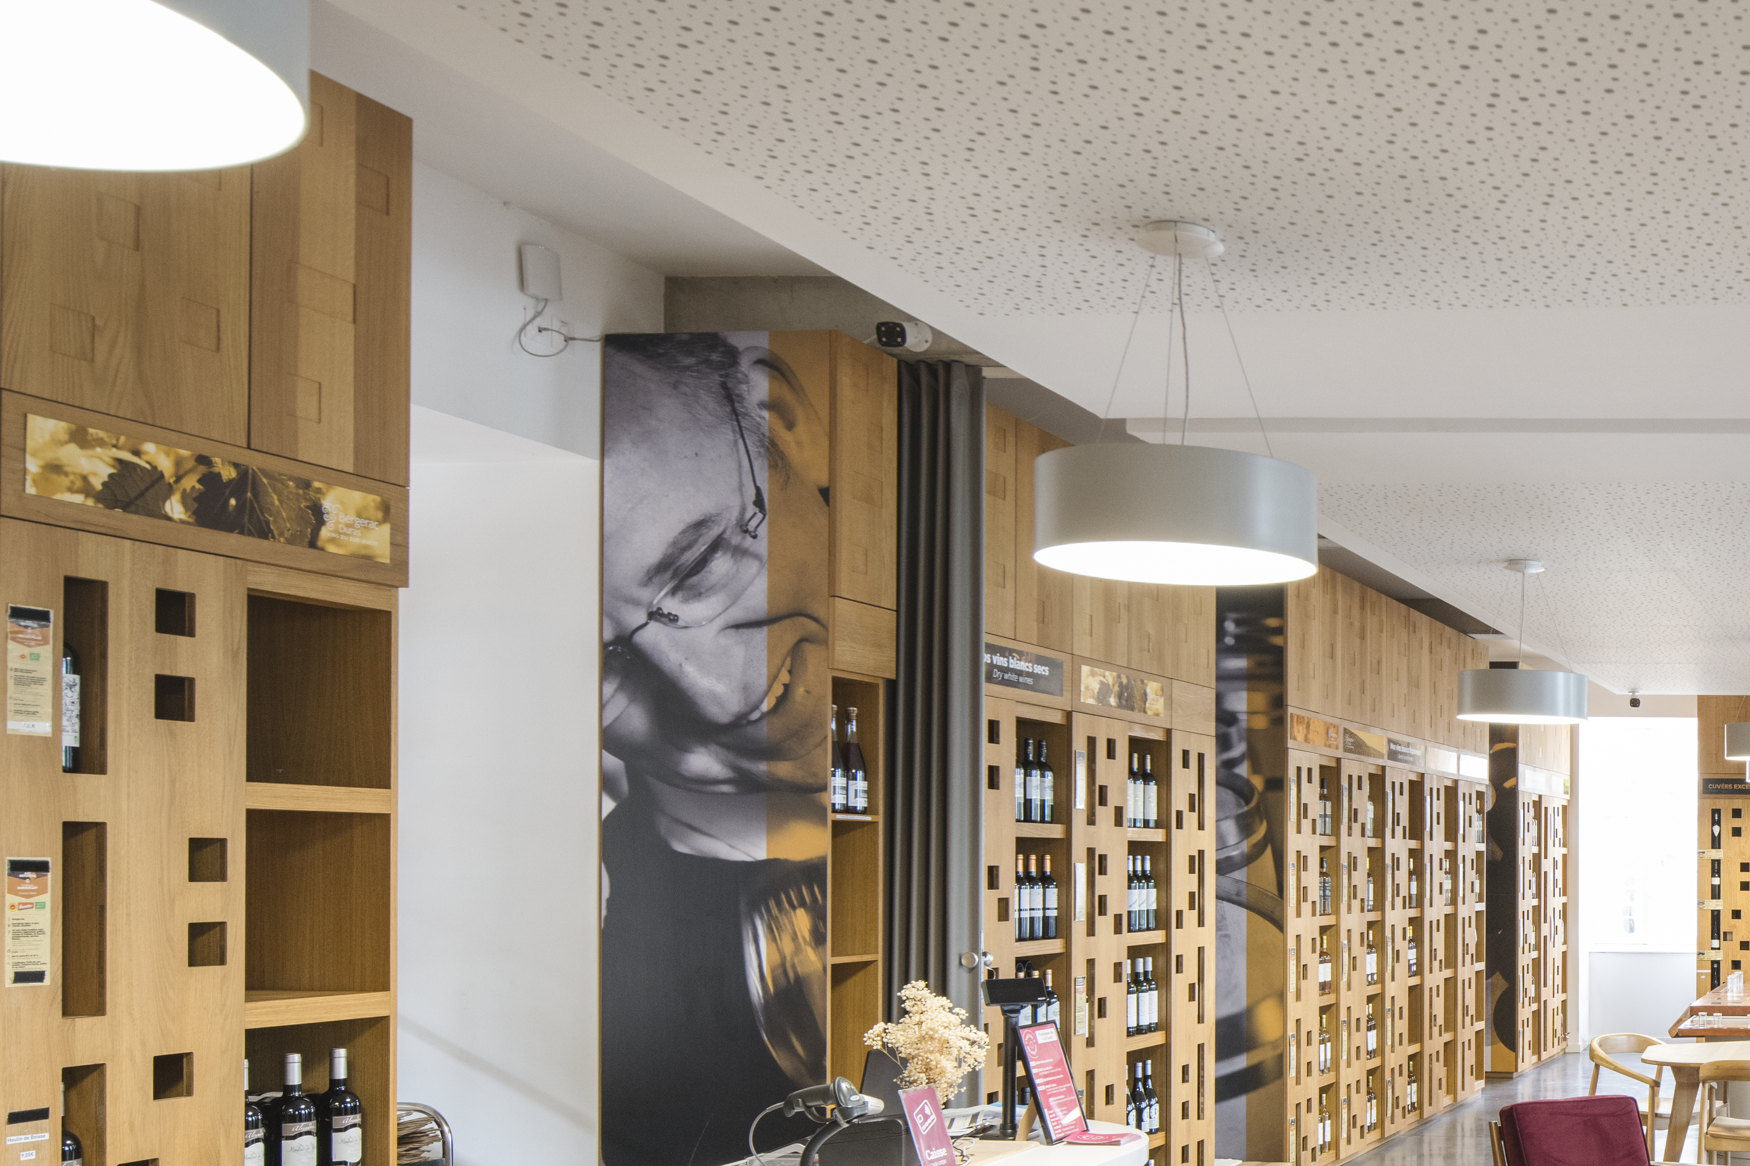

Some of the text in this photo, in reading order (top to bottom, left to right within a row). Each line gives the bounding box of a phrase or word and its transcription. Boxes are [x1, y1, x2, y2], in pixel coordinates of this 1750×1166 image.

[338, 511, 379, 530] Bergerac
[338, 524, 361, 537] Duras
[992, 653, 1009, 668] vins
[1009, 655, 1033, 673] blancs
[1033, 665, 1050, 676] secs
[992, 668, 1034, 686] Dry white wines
[925, 1147, 948, 1160] Caisse
